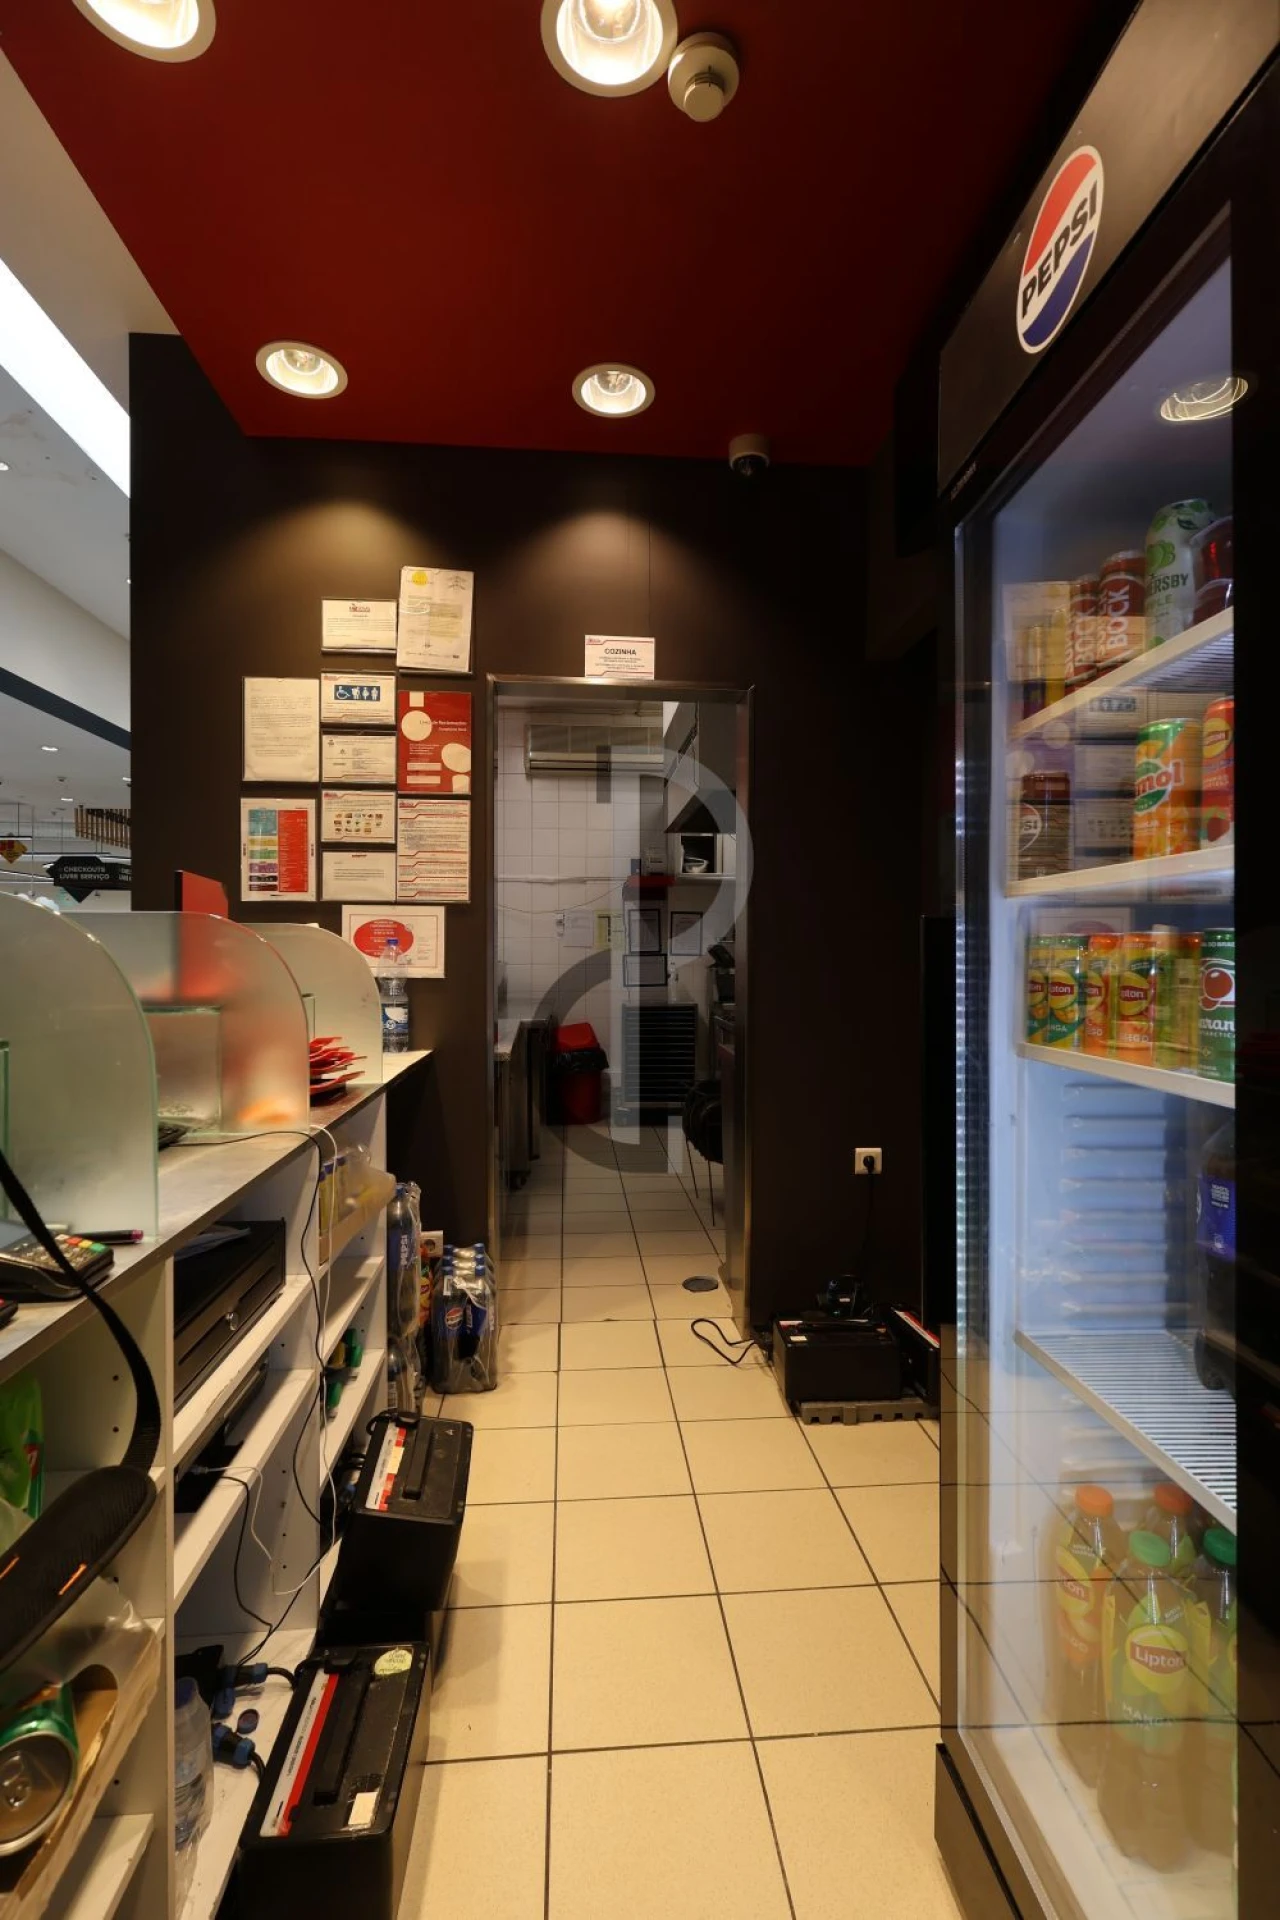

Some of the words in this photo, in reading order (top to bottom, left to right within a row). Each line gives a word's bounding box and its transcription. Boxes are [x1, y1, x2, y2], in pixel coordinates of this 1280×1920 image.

[1021, 180, 1099, 320] PEPSI
[1107, 584, 1129, 650] BOCK
[604, 647, 637, 656] COZINHA
[63, 865, 106, 873] CHECKOUTS
[80, 873, 110, 882] SERVIÇO
[1135, 1645, 1185, 1669] Lipton
